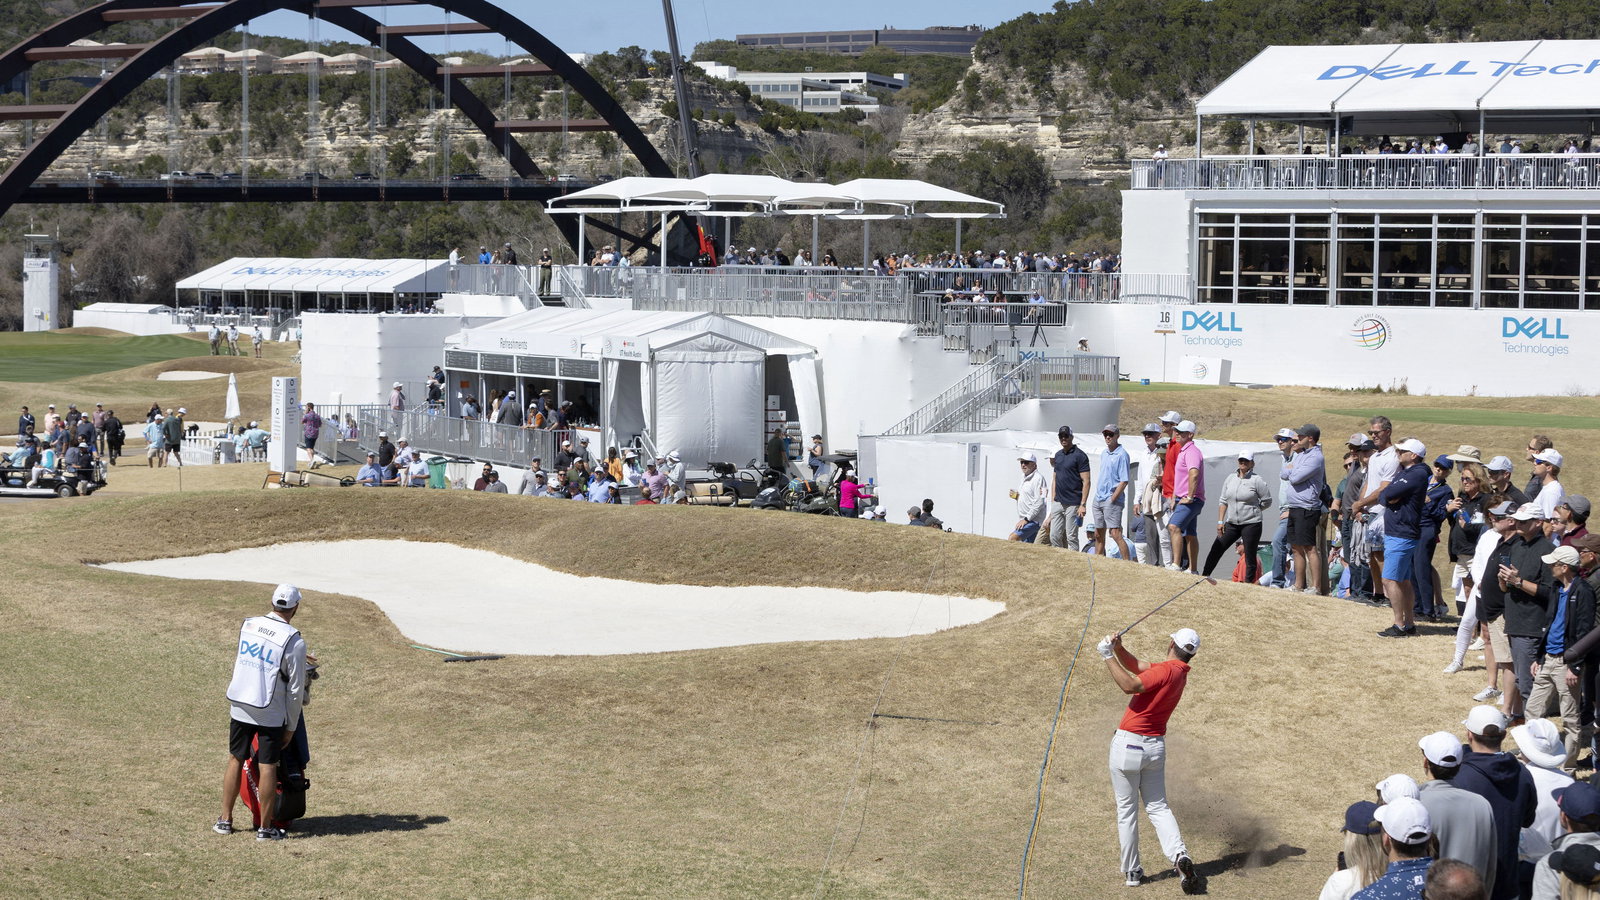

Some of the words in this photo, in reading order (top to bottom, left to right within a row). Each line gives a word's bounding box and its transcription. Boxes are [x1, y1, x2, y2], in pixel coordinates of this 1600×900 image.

[1316, 60, 1478, 80] DELL
[233, 266, 283, 275] DELL
[287, 267, 390, 278] Technologies
[1160, 311, 1171, 323] 16
[1182, 310, 1243, 332] DELL
[1502, 316, 1569, 339] DELL
[500, 337, 527, 349] Refreshments
[1182, 334, 1243, 348] Technologies
[1502, 341, 1569, 357] Technologies
[258, 626, 276, 638] WOLFF
[240, 640, 274, 664] DELL
